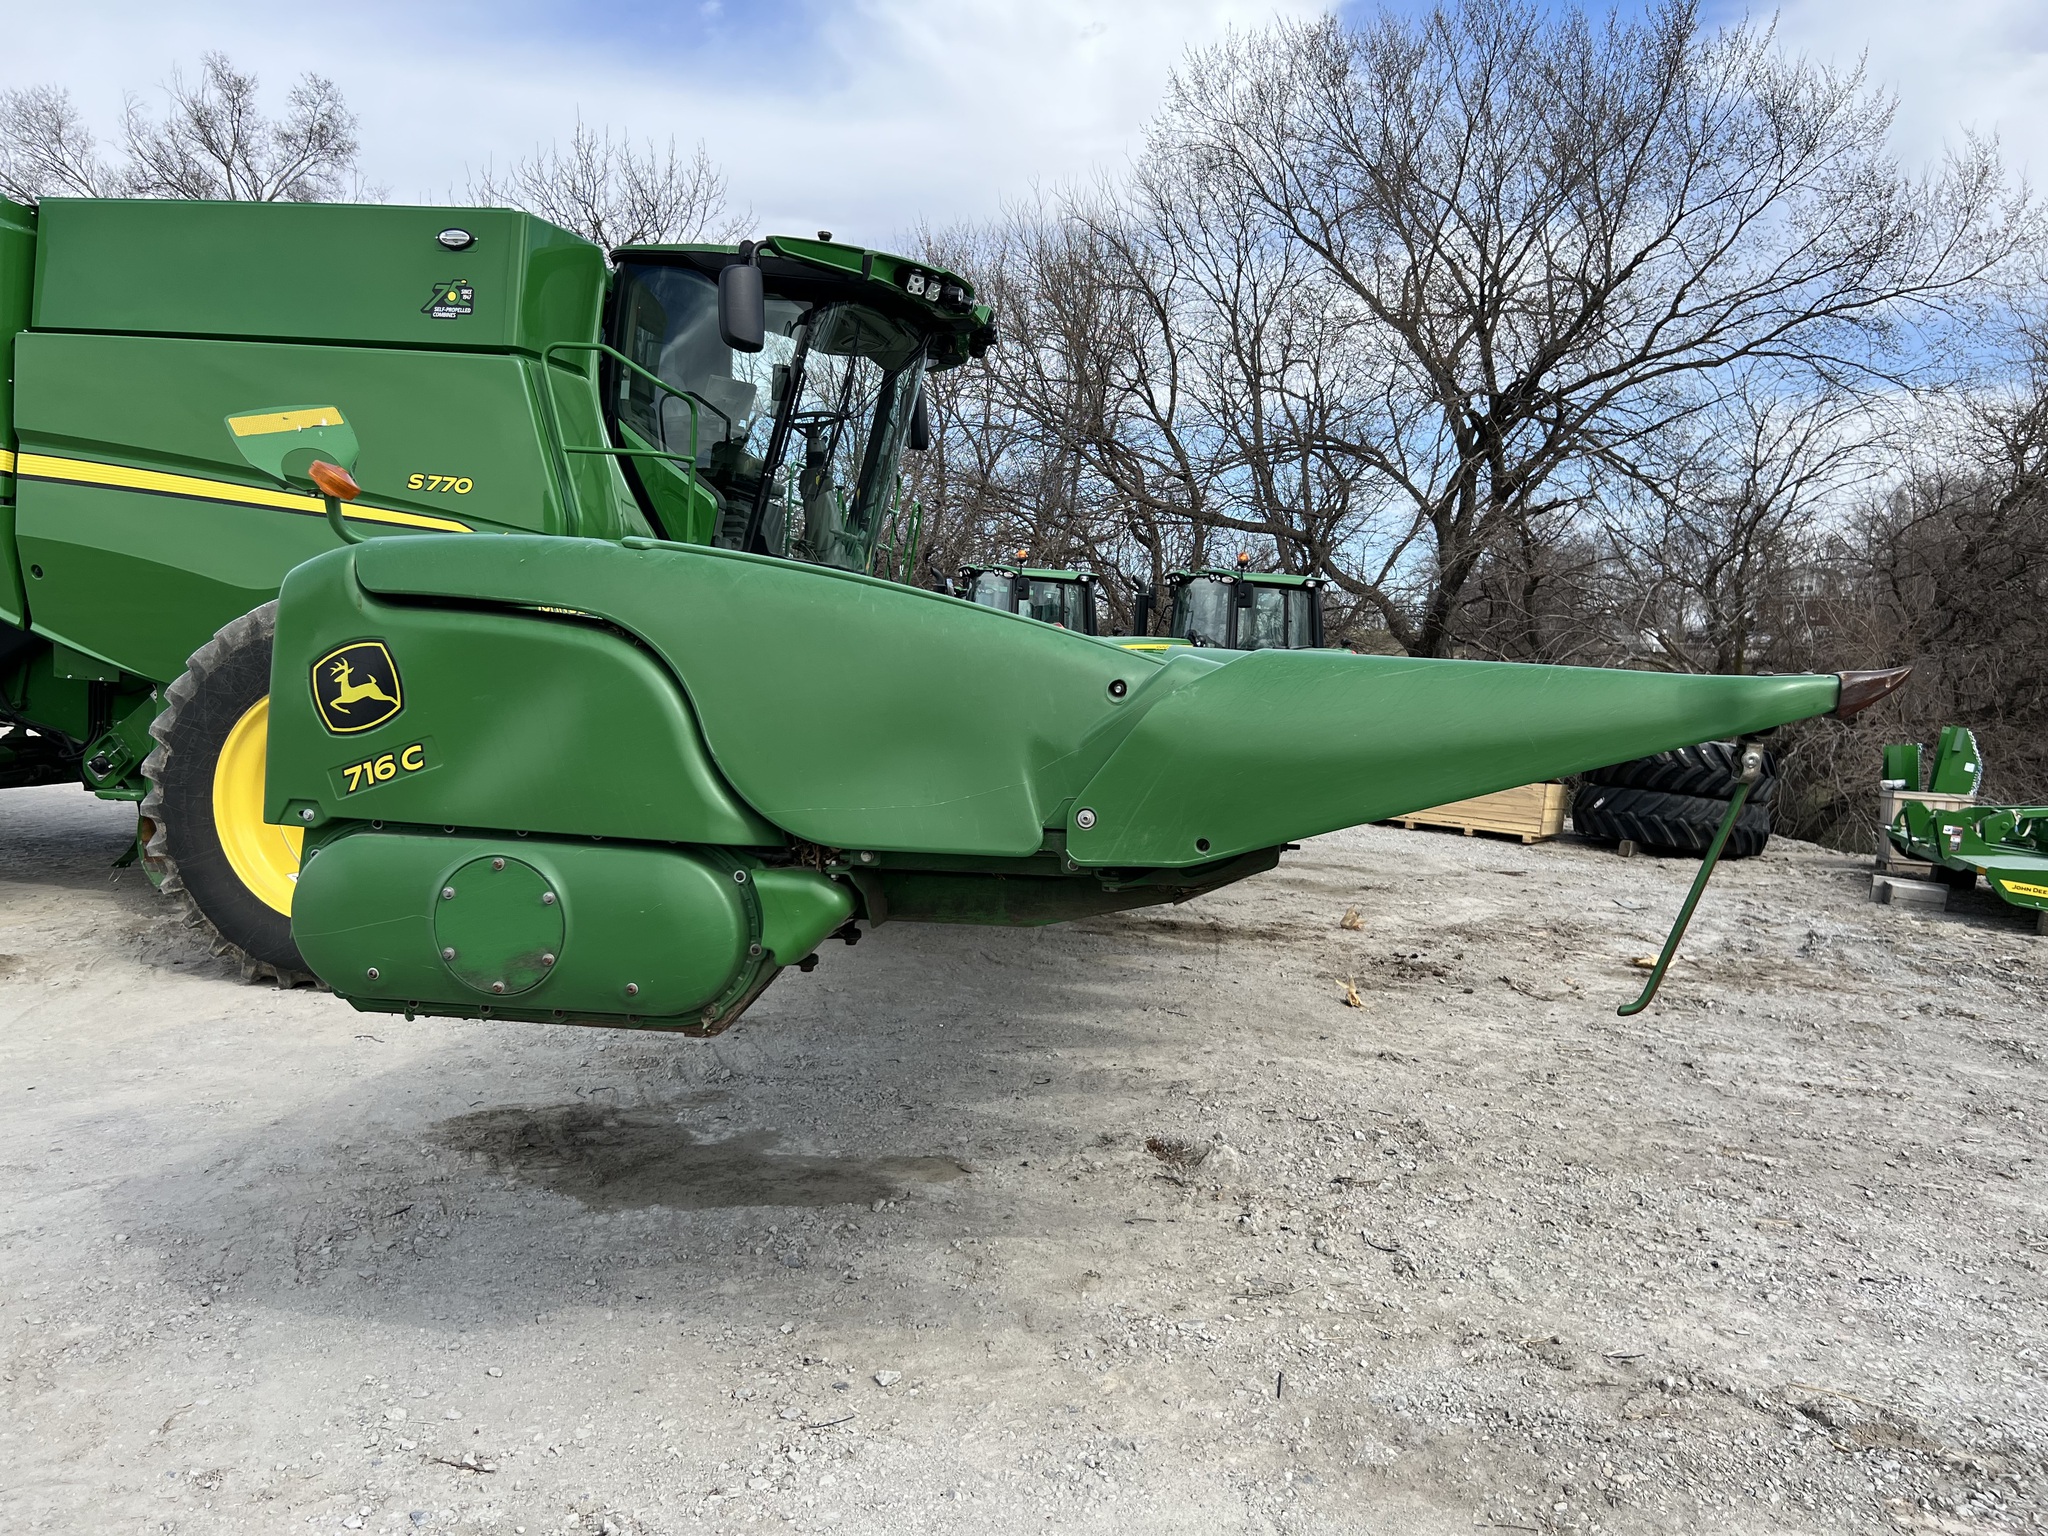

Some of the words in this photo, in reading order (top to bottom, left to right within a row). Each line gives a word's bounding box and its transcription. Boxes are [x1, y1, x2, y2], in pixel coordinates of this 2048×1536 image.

[422, 280, 467, 311] 75
[407, 473, 474, 494] S770
[342, 753, 397, 794] 716
[400, 744, 425, 771] C
[2011, 884, 2032, 892] JOHN
